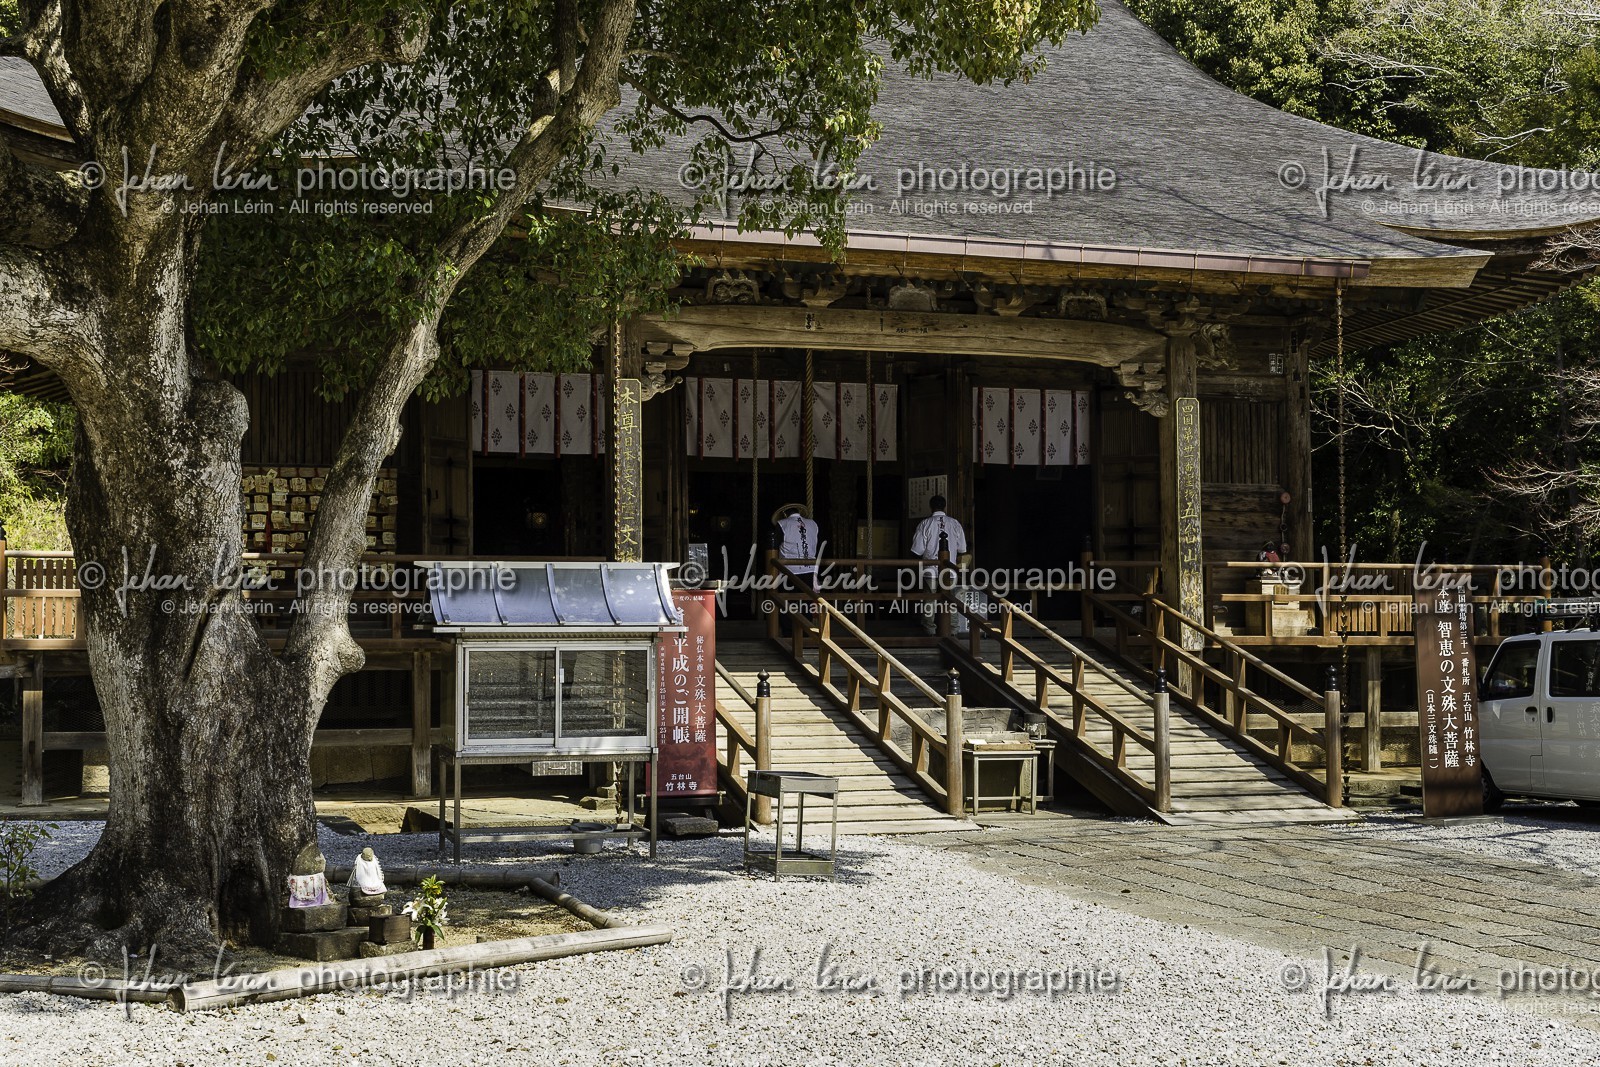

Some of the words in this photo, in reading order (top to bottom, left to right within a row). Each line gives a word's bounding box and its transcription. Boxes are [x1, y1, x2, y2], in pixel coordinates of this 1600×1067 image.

[1463, 727, 1476, 767] 竹林寺
[665, 781, 698, 791] 竹林寺
